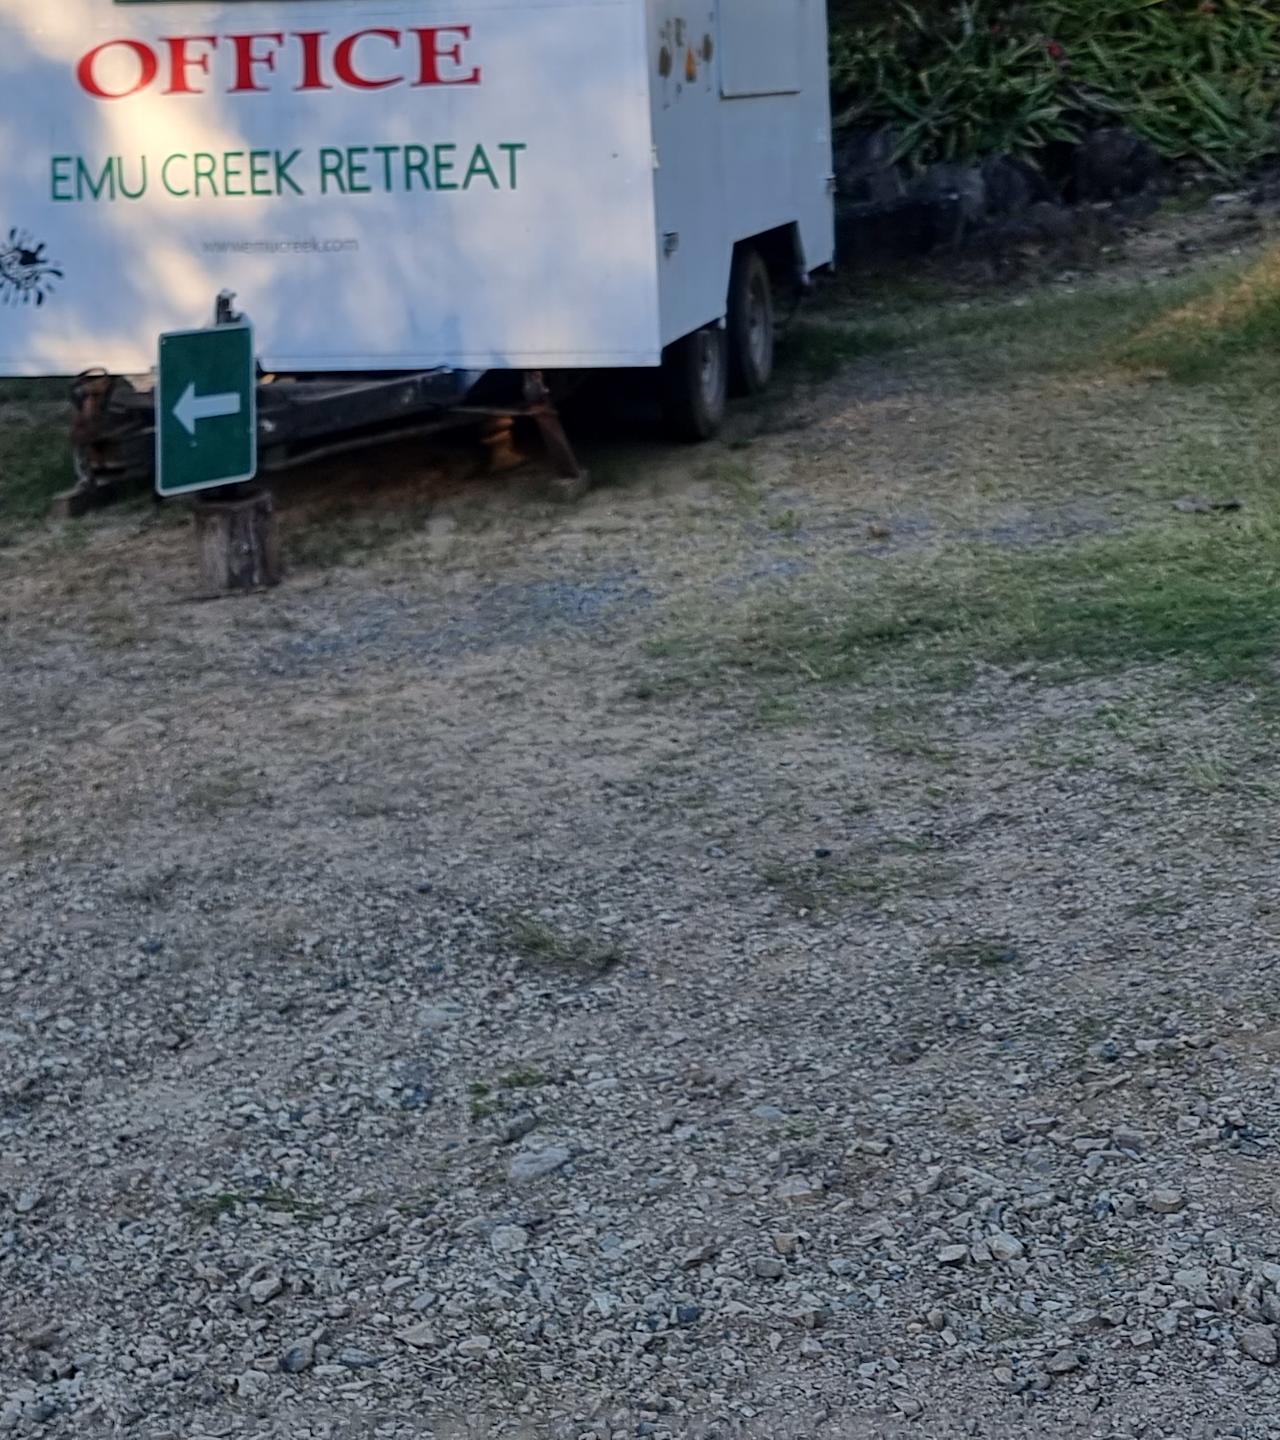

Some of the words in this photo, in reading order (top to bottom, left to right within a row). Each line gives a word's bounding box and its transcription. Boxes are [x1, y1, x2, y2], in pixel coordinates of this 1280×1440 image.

[75, 23, 482, 101] OFFICE
[50, 154, 148, 202] EMU
[161, 148, 304, 198] CREEK
[320, 142, 527, 195] RETREAT
